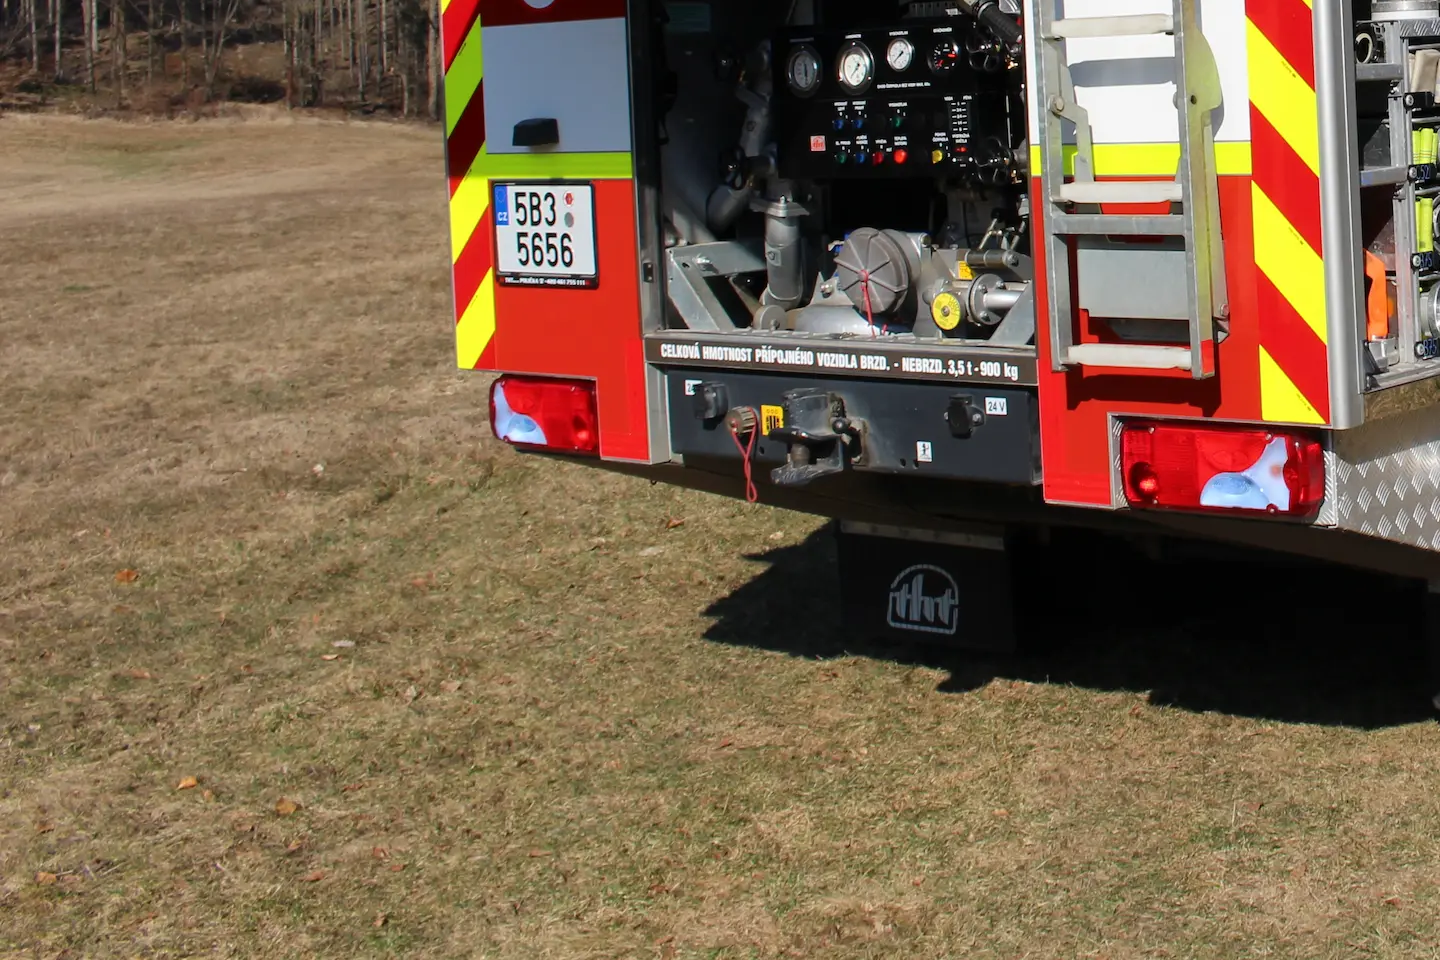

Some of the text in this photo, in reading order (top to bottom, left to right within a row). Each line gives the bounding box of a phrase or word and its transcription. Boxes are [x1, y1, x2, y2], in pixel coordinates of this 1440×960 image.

[497, 191, 557, 227] CZ 5B3
[516, 231, 574, 268] 5656
[660, 342, 701, 359] CELKOVÁ
[702, 346, 753, 362] HMOTNOST
[755, 346, 814, 366] PŘÍPOJNÉHO
[817, 352, 858, 369] VOZIDLA
[860, 354, 890, 371] BRZD.
[901, 357, 946, 374] NEBRZD.
[948, 359, 965, 378] 3,5
[1004, 362, 1019, 381] kg
[988, 400, 1005, 412] 24 V
